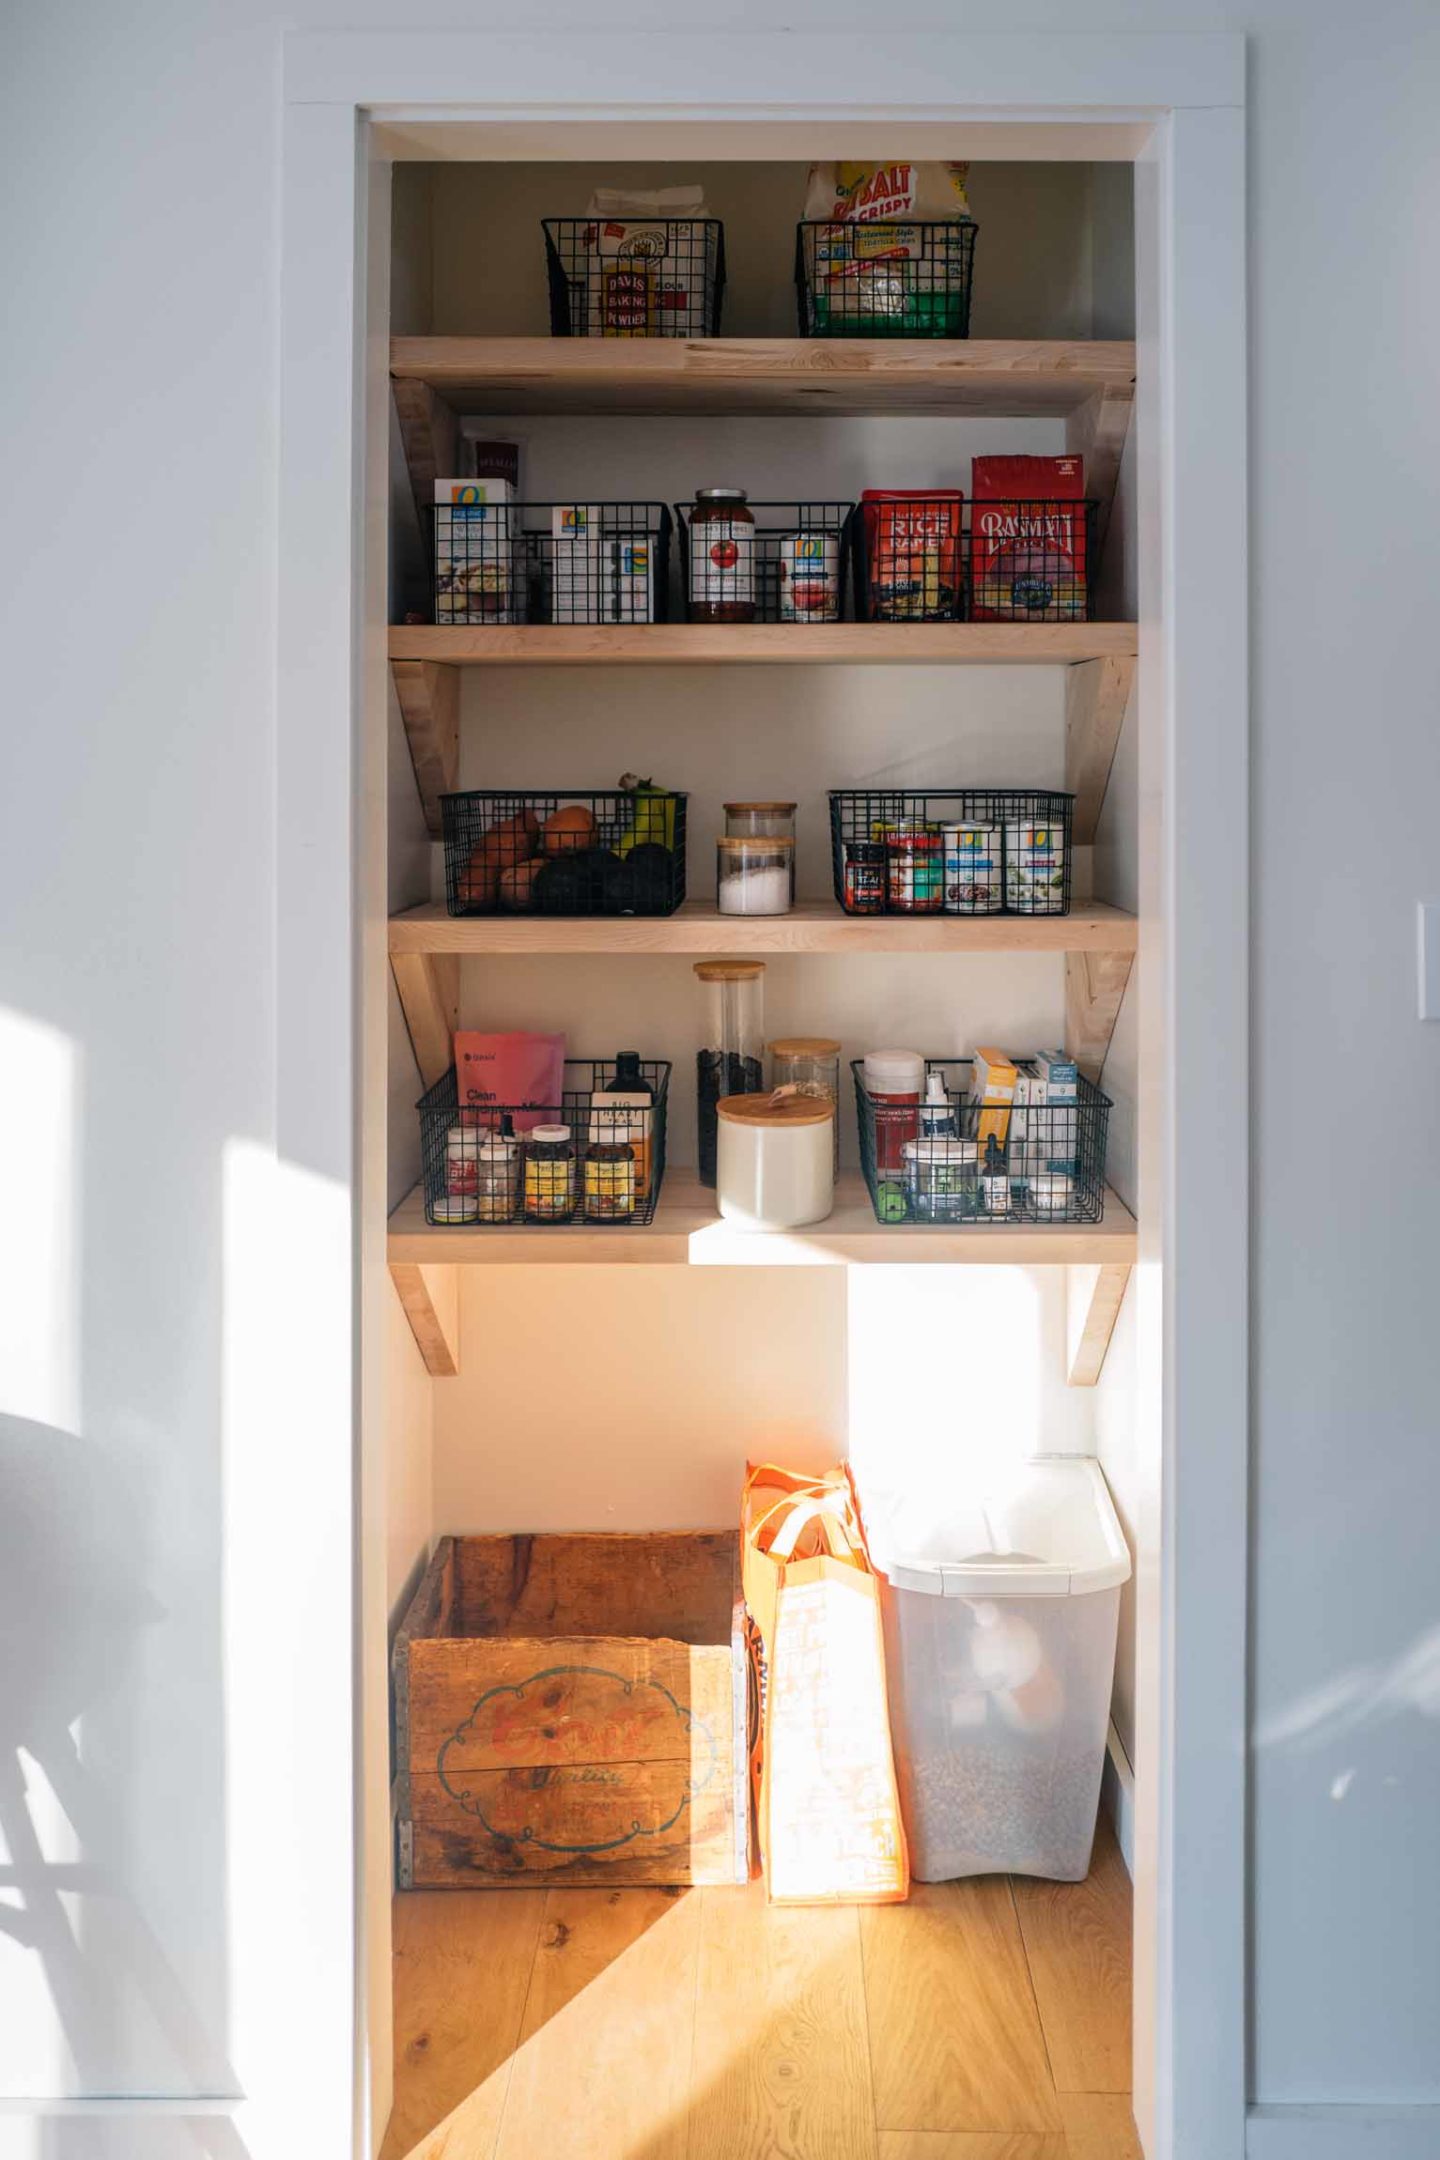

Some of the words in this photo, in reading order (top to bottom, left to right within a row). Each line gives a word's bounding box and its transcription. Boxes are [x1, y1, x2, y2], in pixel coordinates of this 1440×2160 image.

[858, 165, 911, 206] SALT
[857, 197, 912, 223] CRISPY
[609, 275, 645, 291] DAVIS
[656, 282, 684, 290] FOUR
[608, 296, 646, 307] BAKNG
[608, 312, 646, 326] POWDER
[890, 517, 950, 536] RICE
[981, 512, 1074, 556] BASMATI
[466, 1088, 497, 1101] Clean
